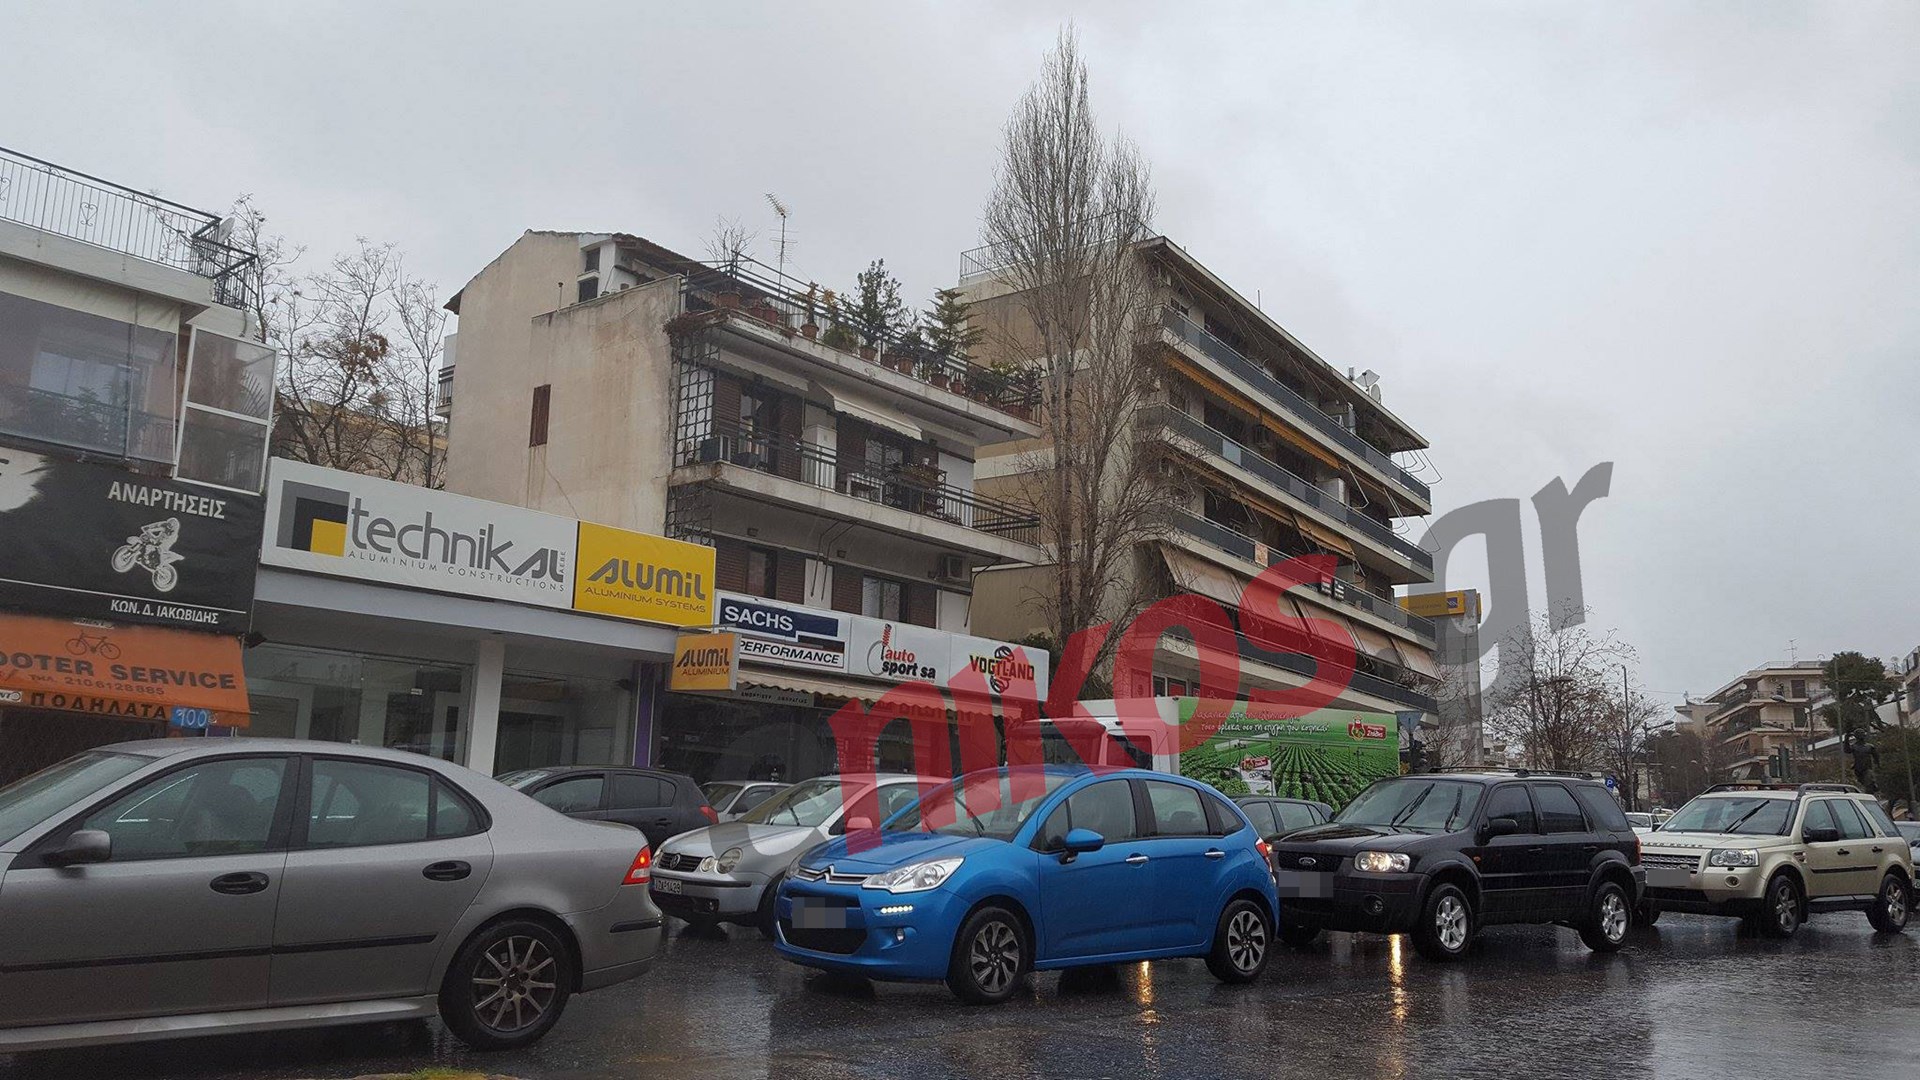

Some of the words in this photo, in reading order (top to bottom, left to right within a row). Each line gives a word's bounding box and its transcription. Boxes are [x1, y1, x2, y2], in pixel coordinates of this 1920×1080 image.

[107, 480, 226, 519] ΑΝΑΡΤΗΣΕΙΣ
[347, 550, 438, 572] ALUMINIUM
[447, 566, 565, 592] CONSTRUCTIONS
[110, 600, 140, 614] ΚΩΝ.
[142, 604, 155, 616] Δ.
[156, 605, 219, 624] ΙΑΚΩΒΙΔΗΣ
[585, 586, 652, 604] ALUMINIUM
[655, 598, 706, 613] SYSTEMS
[724, 605, 793, 632] SACHS
[740, 640, 840, 664] PERFORMANCE
[885, 649, 915, 663] auto
[110, 664, 237, 690] SERVICE
[682, 667, 730, 676] ALUMINIUM
[882, 660, 918, 676] sport
[920, 666, 936, 679] sa
[969, 654, 1035, 681] VOGTLAND
[30, 692, 167, 719] ΠΟΔΗΛΑΤΑ
